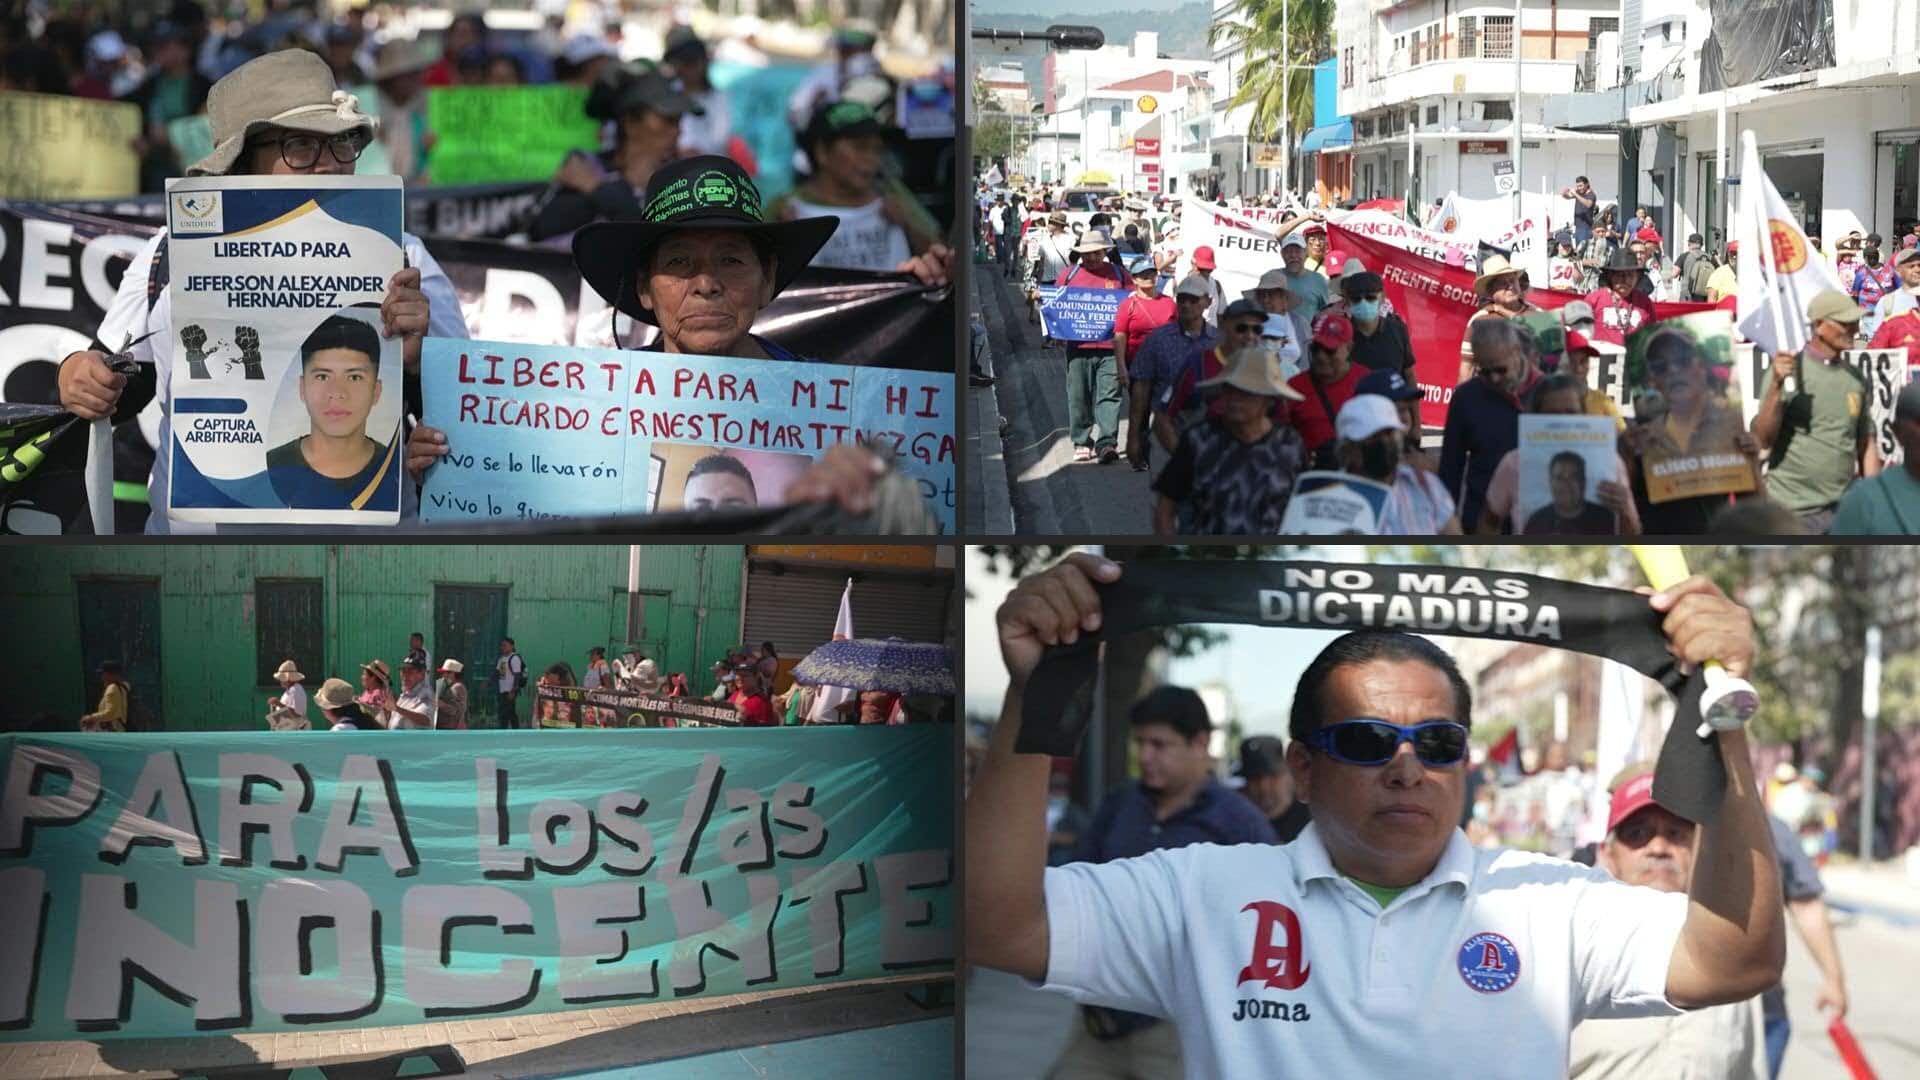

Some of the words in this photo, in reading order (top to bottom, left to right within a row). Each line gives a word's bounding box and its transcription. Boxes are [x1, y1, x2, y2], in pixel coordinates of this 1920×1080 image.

[214, 242, 297, 257] LIBERTAD
[301, 242, 351, 258] PARA
[184, 275, 274, 292] JEFERSON
[277, 277, 384, 292] ALEXANDER
[1382, 264, 1440, 295] FRENTE
[228, 292, 343, 308] HERNANDEZ.
[1050, 301, 1118, 312] COMUNIDADES
[673, 367, 760, 404] PARA
[791, 379, 850, 411] MI
[459, 393, 590, 431] RICARDO
[194, 418, 256, 431] CAPTURA
[185, 431, 263, 444] ARBITRARIA
[483, 456, 501, 471] se
[509, 452, 524, 473] lo
[487, 494, 502, 516] lo
[1284, 568, 1374, 590] NO
[1398, 573, 1530, 599] MAS
[1258, 589, 1562, 641] DICTADURA
[0, 744, 420, 878] PARA
